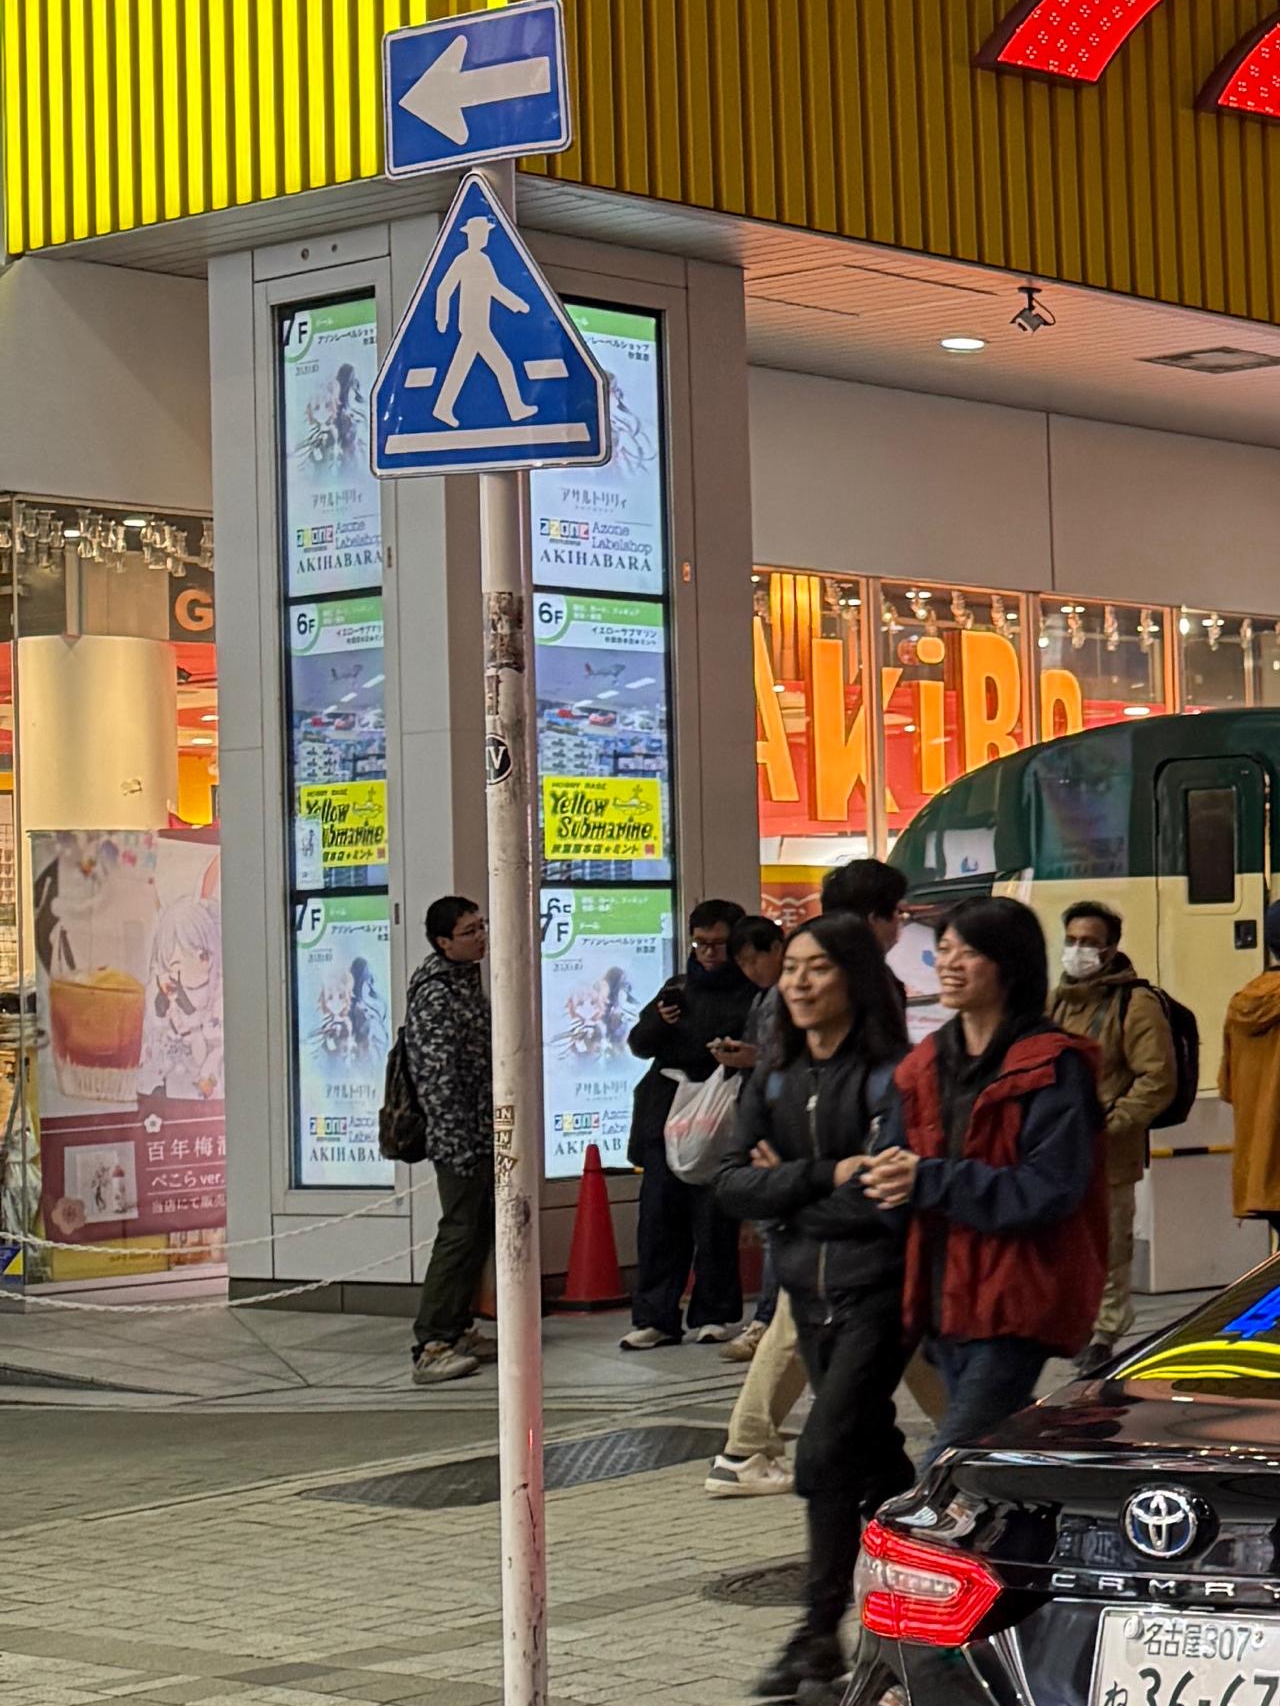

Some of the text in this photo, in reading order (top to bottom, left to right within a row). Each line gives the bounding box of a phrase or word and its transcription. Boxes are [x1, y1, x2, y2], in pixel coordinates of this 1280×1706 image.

[540, 548, 653, 572] AKIHABARA
[296, 612, 316, 636] 6F
[538, 601, 564, 625] 6F
[550, 791, 610, 817] Yellow
